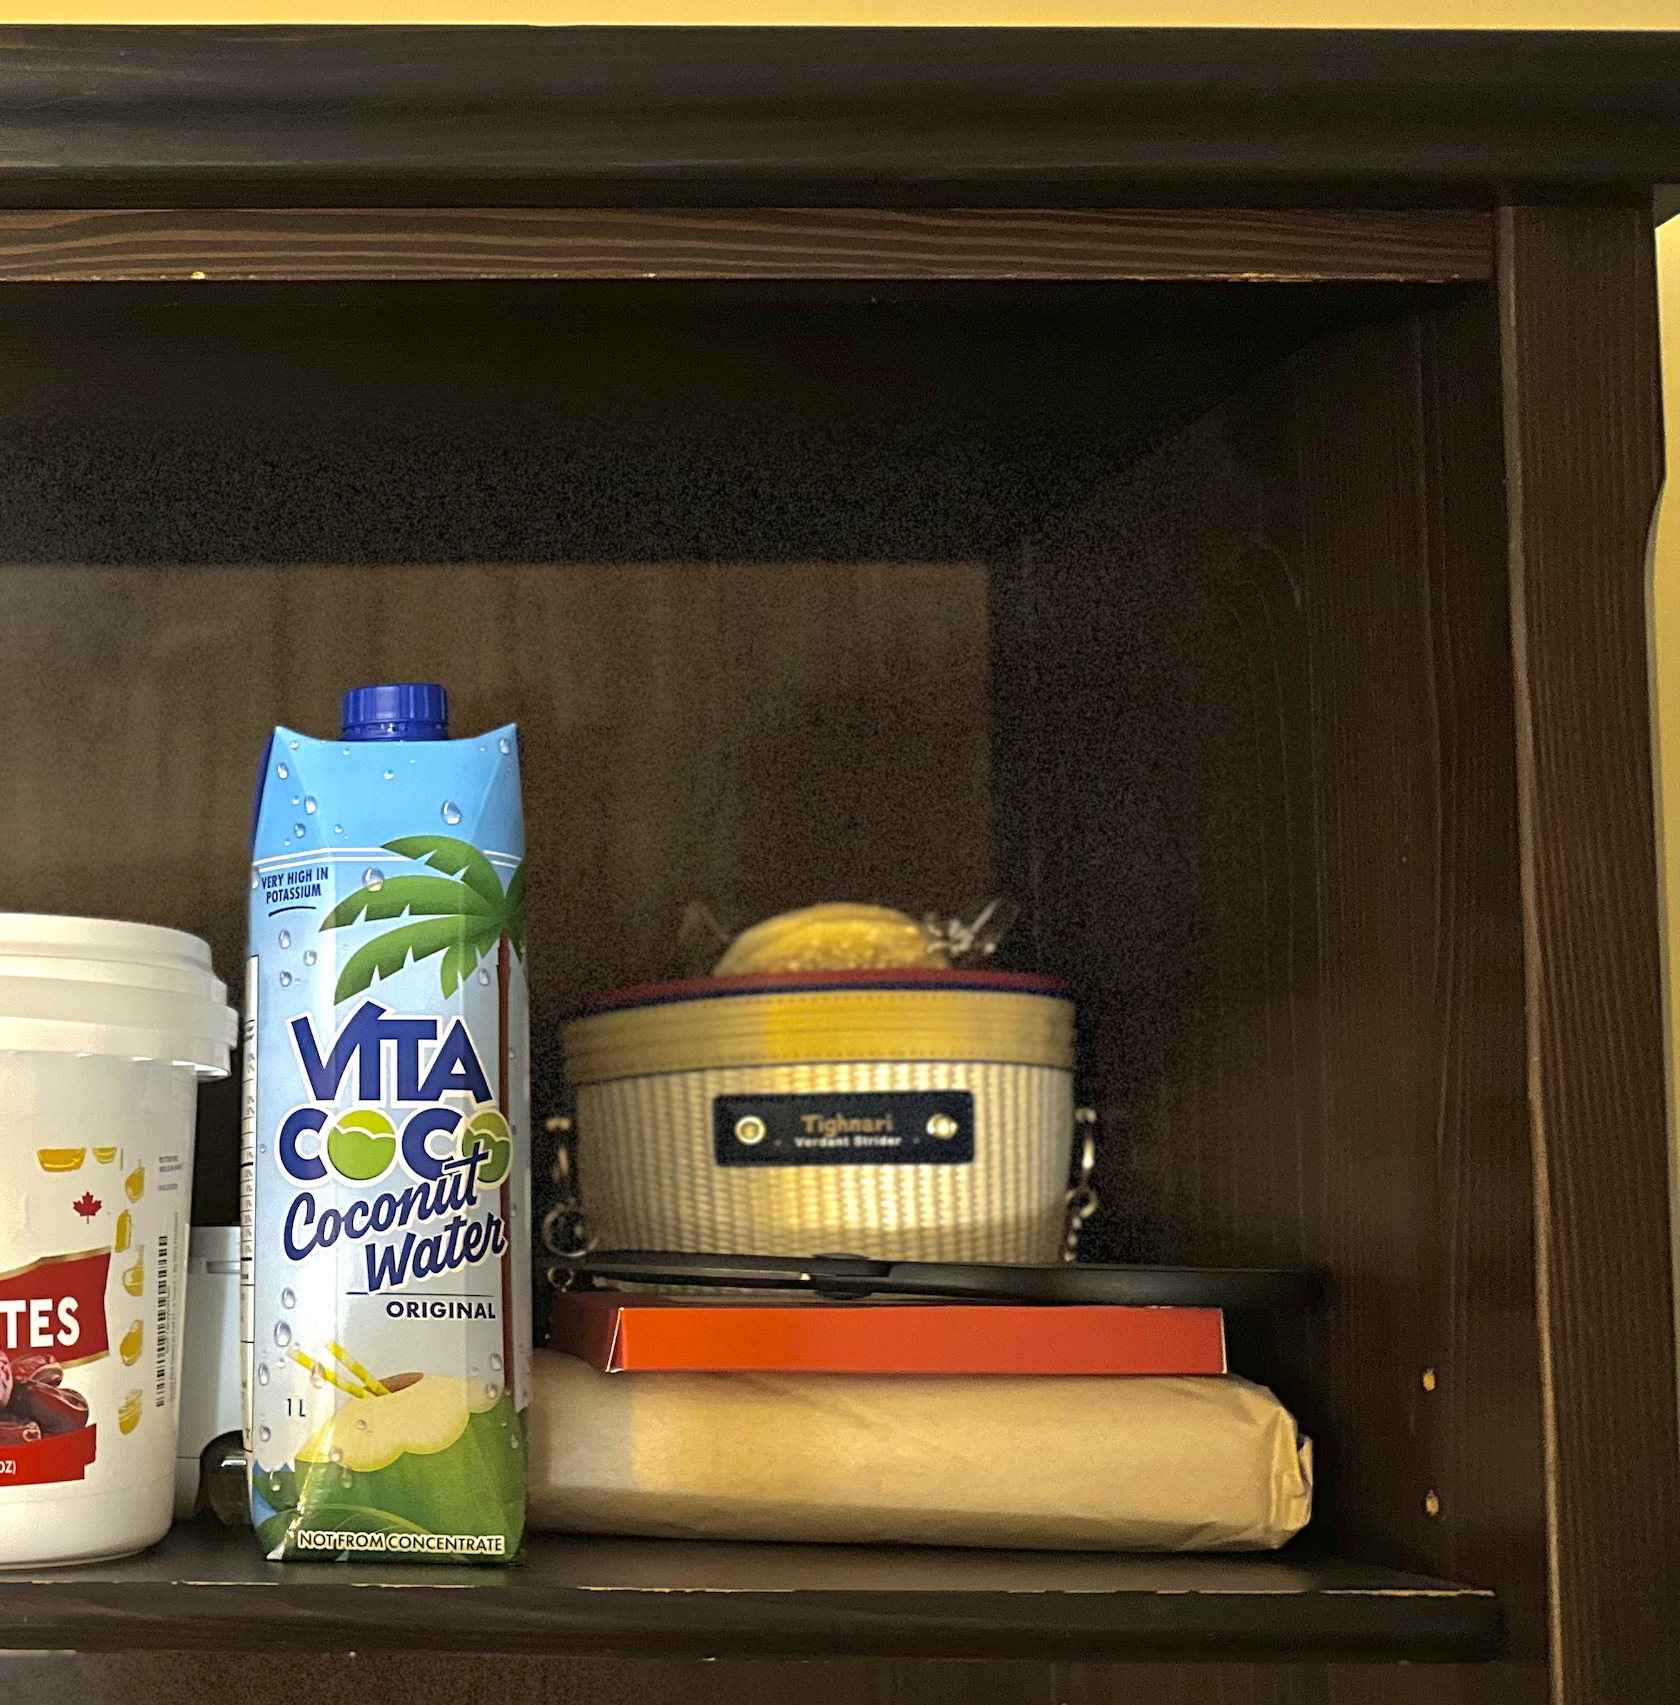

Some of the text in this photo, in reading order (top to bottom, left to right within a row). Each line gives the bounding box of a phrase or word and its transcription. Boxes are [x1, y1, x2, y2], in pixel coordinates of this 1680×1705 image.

[261, 866, 329, 889] VERY HIGH IN
[266, 883, 322, 904] POTASSIUM
[291, 1000, 494, 1104] VITA
[801, 1112, 893, 1138] Tighnari
[279, 1108, 511, 1183] COCO
[794, 1136, 902, 1147] Verdant Strider
[283, 1142, 490, 1261] Coconut
[366, 1211, 507, 1293] Water
[386, 1301, 496, 1319] ORIGINAL
[287, 1398, 306, 1417] 1 L
[299, 1533, 503, 1552] NOT FROM CONCENTRATE
